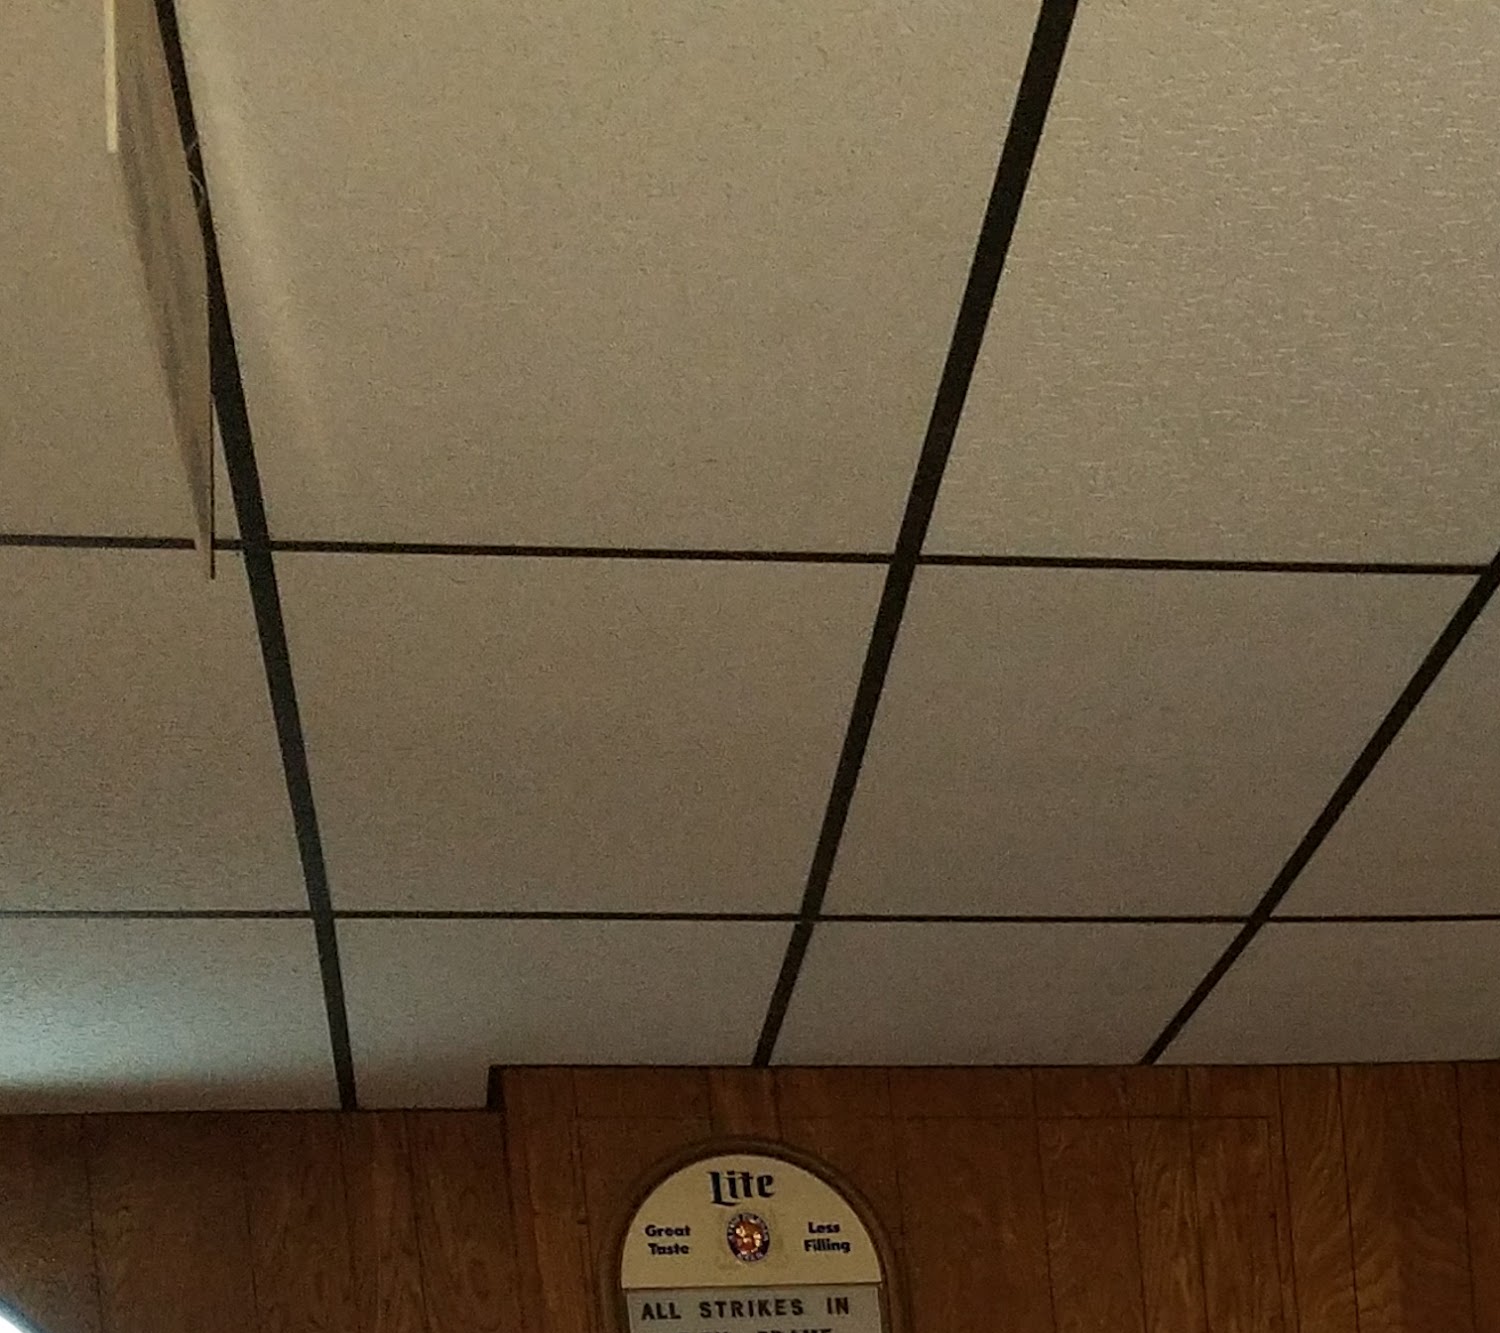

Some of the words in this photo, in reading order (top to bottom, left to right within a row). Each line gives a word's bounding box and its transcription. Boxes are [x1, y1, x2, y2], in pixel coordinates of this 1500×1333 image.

[707, 1170, 776, 1207] Lite
[645, 1224, 690, 1238] Great
[808, 1222, 840, 1234] Less
[647, 1242, 690, 1255] Taste
[804, 1239, 850, 1253] Filling
[641, 1302, 681, 1320] ALL
[699, 1299, 804, 1318] STRIKES
[827, 1297, 849, 1315] IN
